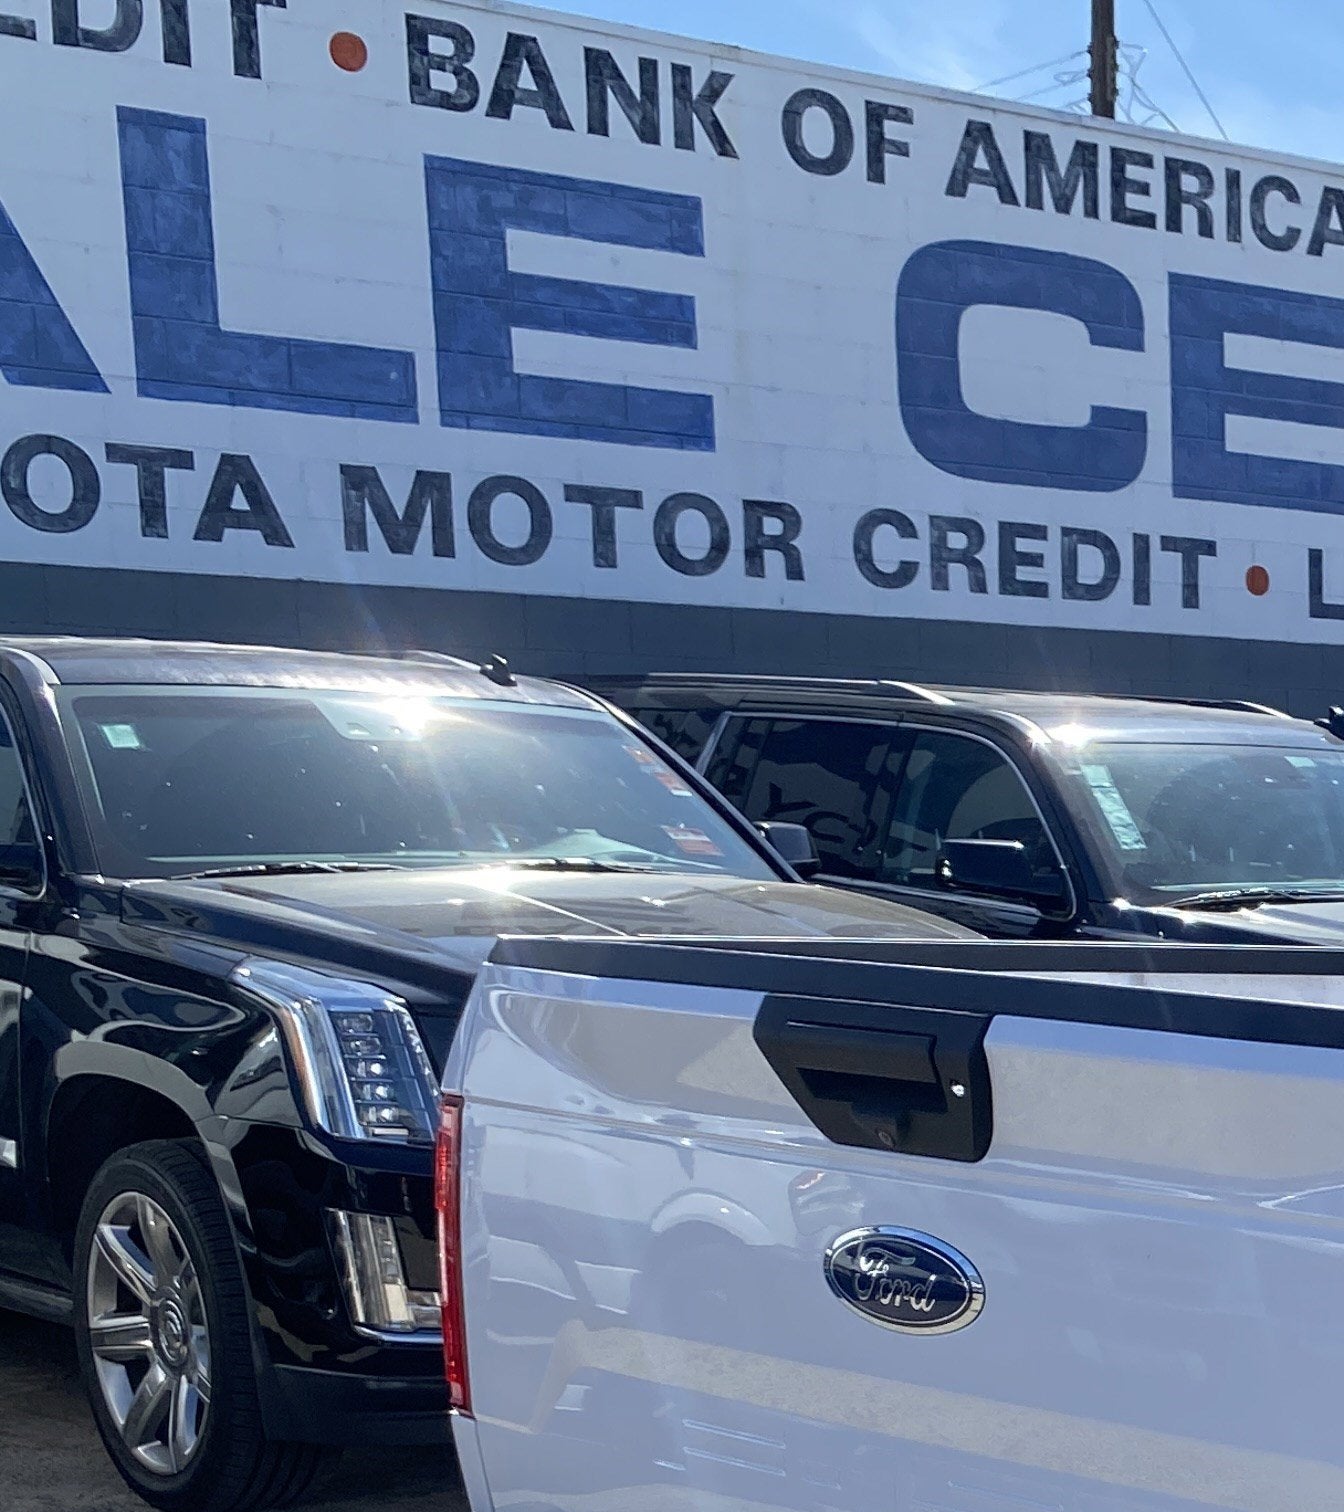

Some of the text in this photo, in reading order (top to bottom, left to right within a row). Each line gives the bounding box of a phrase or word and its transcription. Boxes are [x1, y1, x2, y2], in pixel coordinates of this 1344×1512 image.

[405, 12, 739, 160] BANK
[781, 88, 914, 184] OF
[1, 434, 295, 549] OTA
[340, 463, 805, 582] MOTOR
[853, 508, 1217, 609] CREDIT
